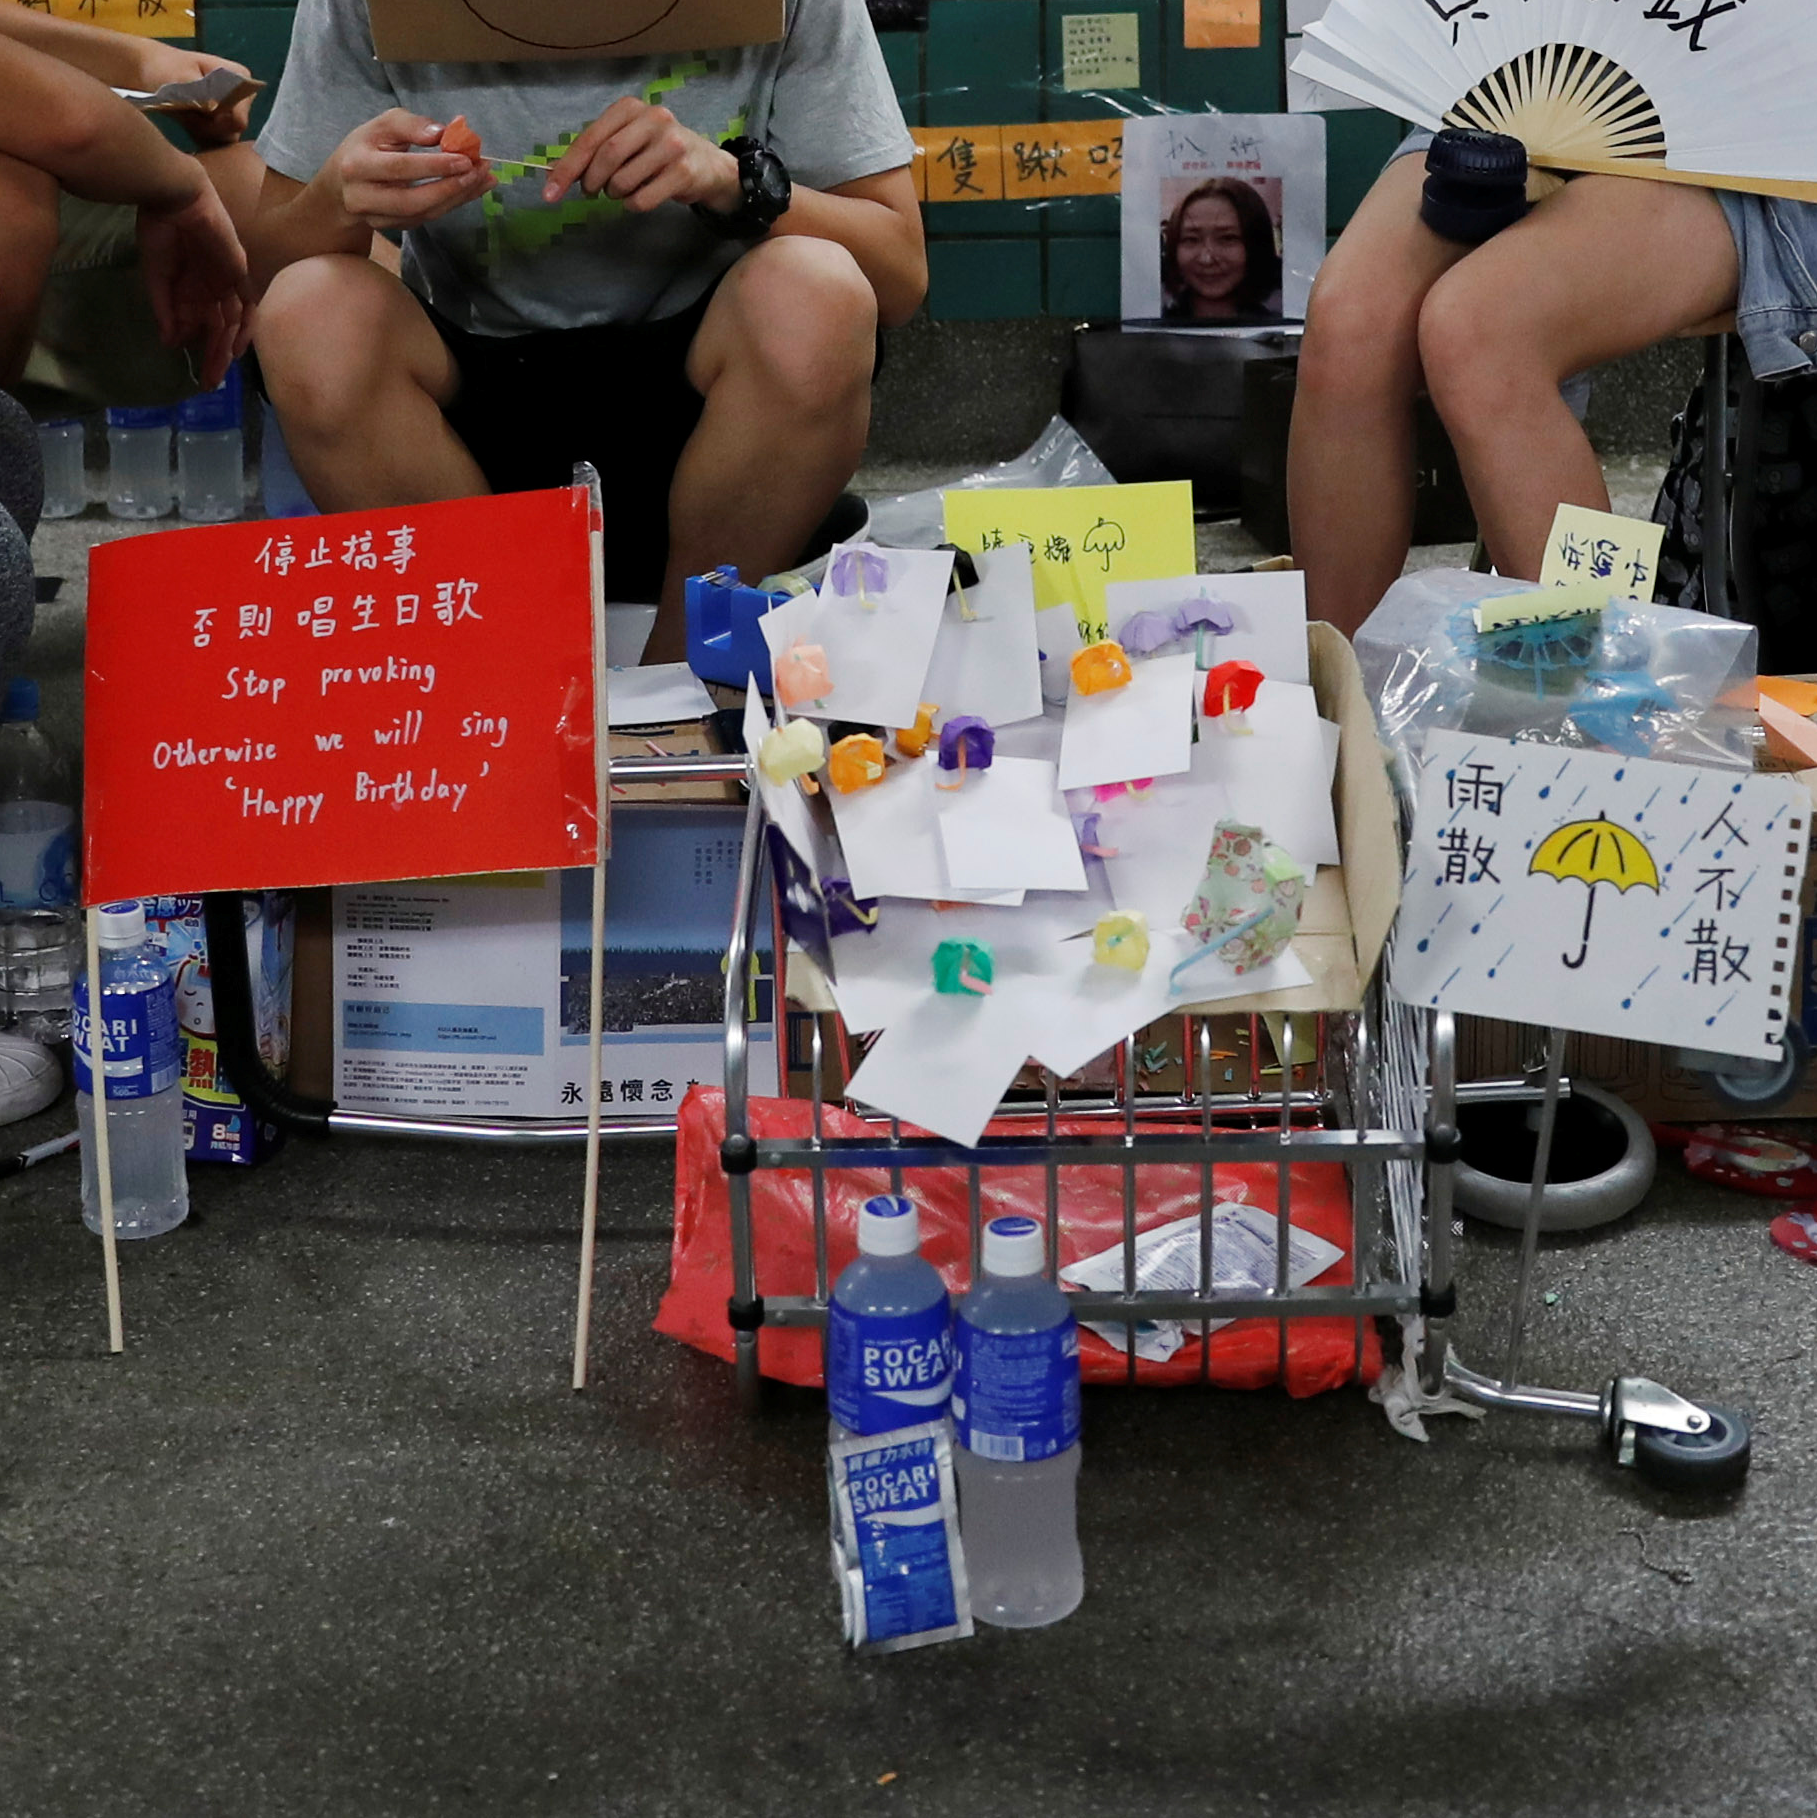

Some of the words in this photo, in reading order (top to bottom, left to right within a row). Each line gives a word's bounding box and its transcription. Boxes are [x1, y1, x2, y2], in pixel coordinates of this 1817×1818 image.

[254, 526, 418, 577] 停止搞事
[192, 578, 484, 650] 否則唱生日歌
[221, 664, 287, 705] Stop
[320, 656, 438, 698] provoking
[152, 735, 278, 774] Otherwise
[314, 729, 345, 755] we
[375, 710, 424, 750] will
[460, 709, 510, 750] sing
[850, 1463, 936, 1499] POCARI
[852, 1481, 931, 1515] SWEAT
